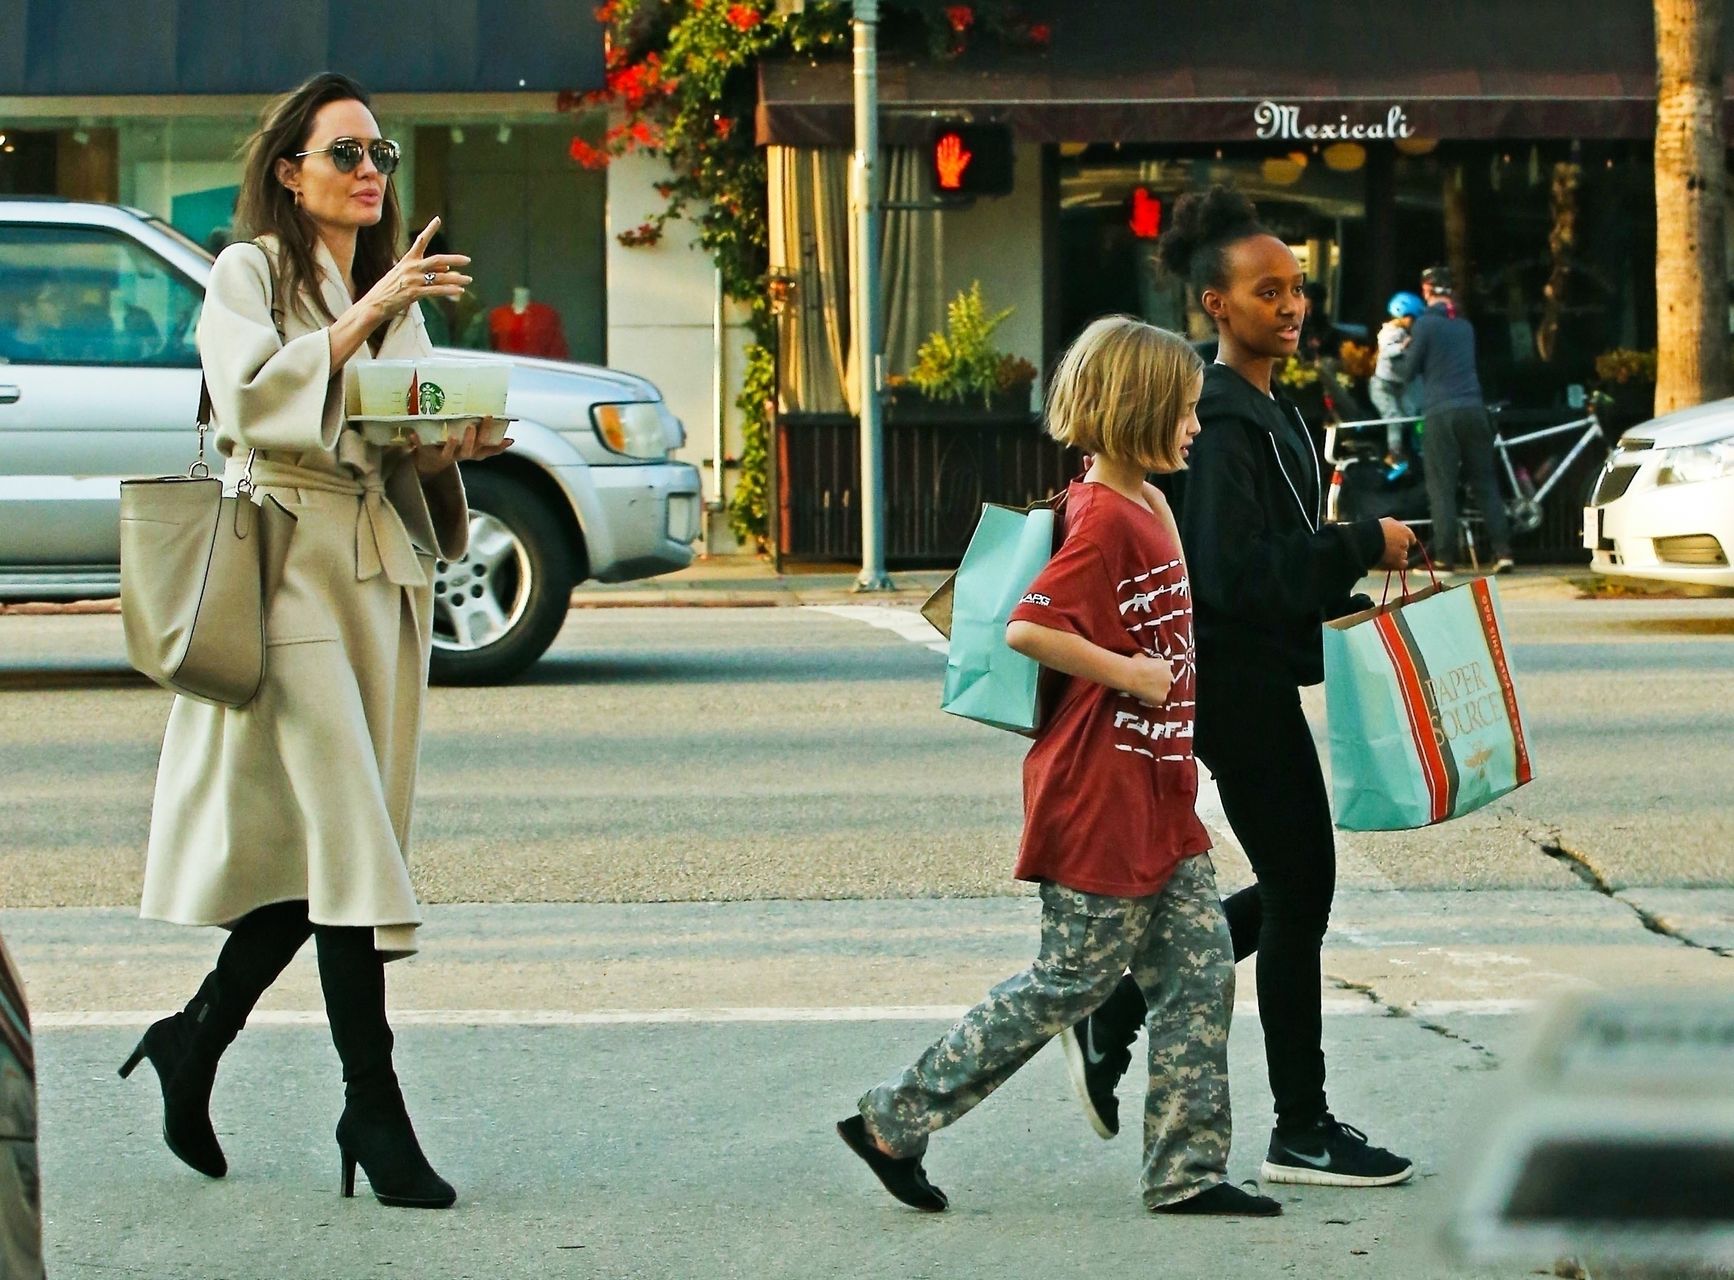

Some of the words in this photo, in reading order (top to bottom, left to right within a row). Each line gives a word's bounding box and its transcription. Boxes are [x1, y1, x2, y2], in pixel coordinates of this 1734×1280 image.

[1254, 100, 1416, 139] Mexicali
[1425, 661, 1488, 710] PAPER
[1431, 691, 1502, 746] SOURCE
